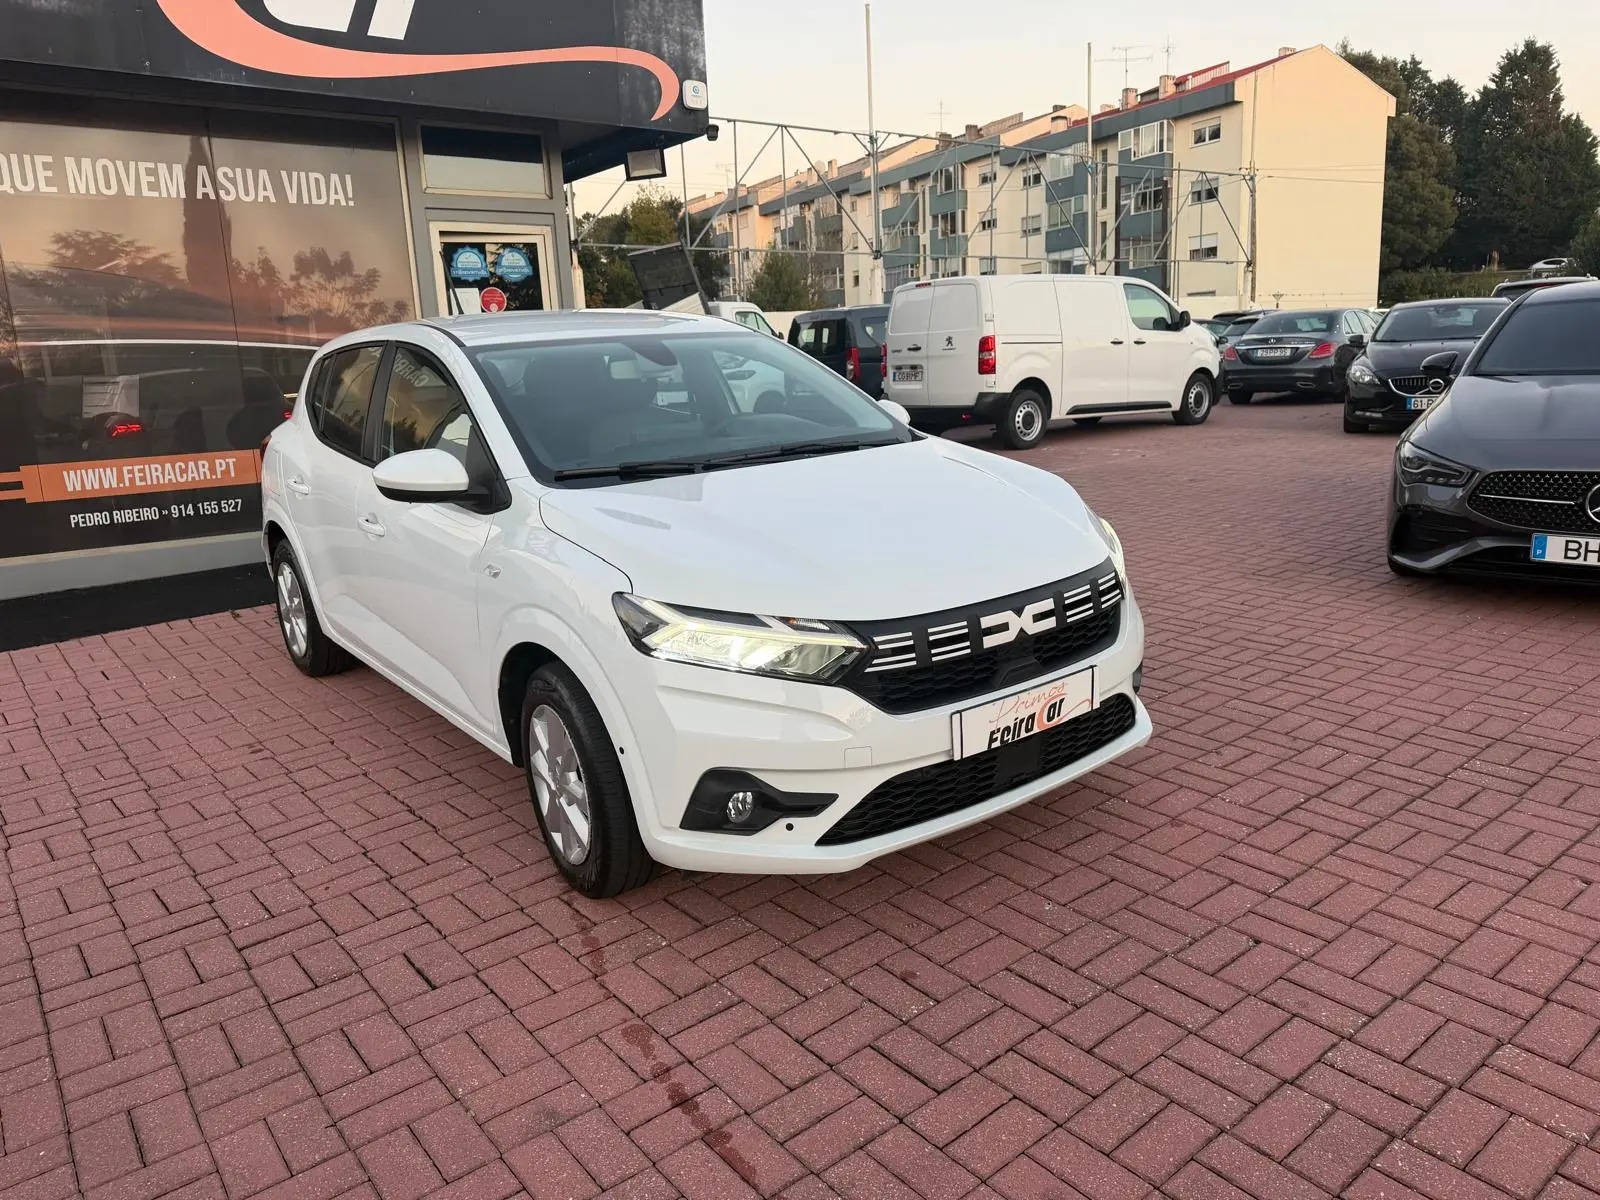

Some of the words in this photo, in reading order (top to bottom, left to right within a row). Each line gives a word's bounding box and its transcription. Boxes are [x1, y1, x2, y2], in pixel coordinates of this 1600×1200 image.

[64, 156, 187, 199] MOVEM
[196, 165, 216, 200] A
[216, 167, 277, 204] SUA
[281, 170, 355, 207] VIDA!
[62, 458, 236, 492] WWW.FEIRACAR.PT
[70, 511, 111, 528] PEDRO
[113, 506, 160, 524] RIBEIRO
[172, 503, 194, 518] 914
[197, 501, 219, 515] 155
[221, 498, 242, 513] 527
[989, 682, 1068, 730] Primos
